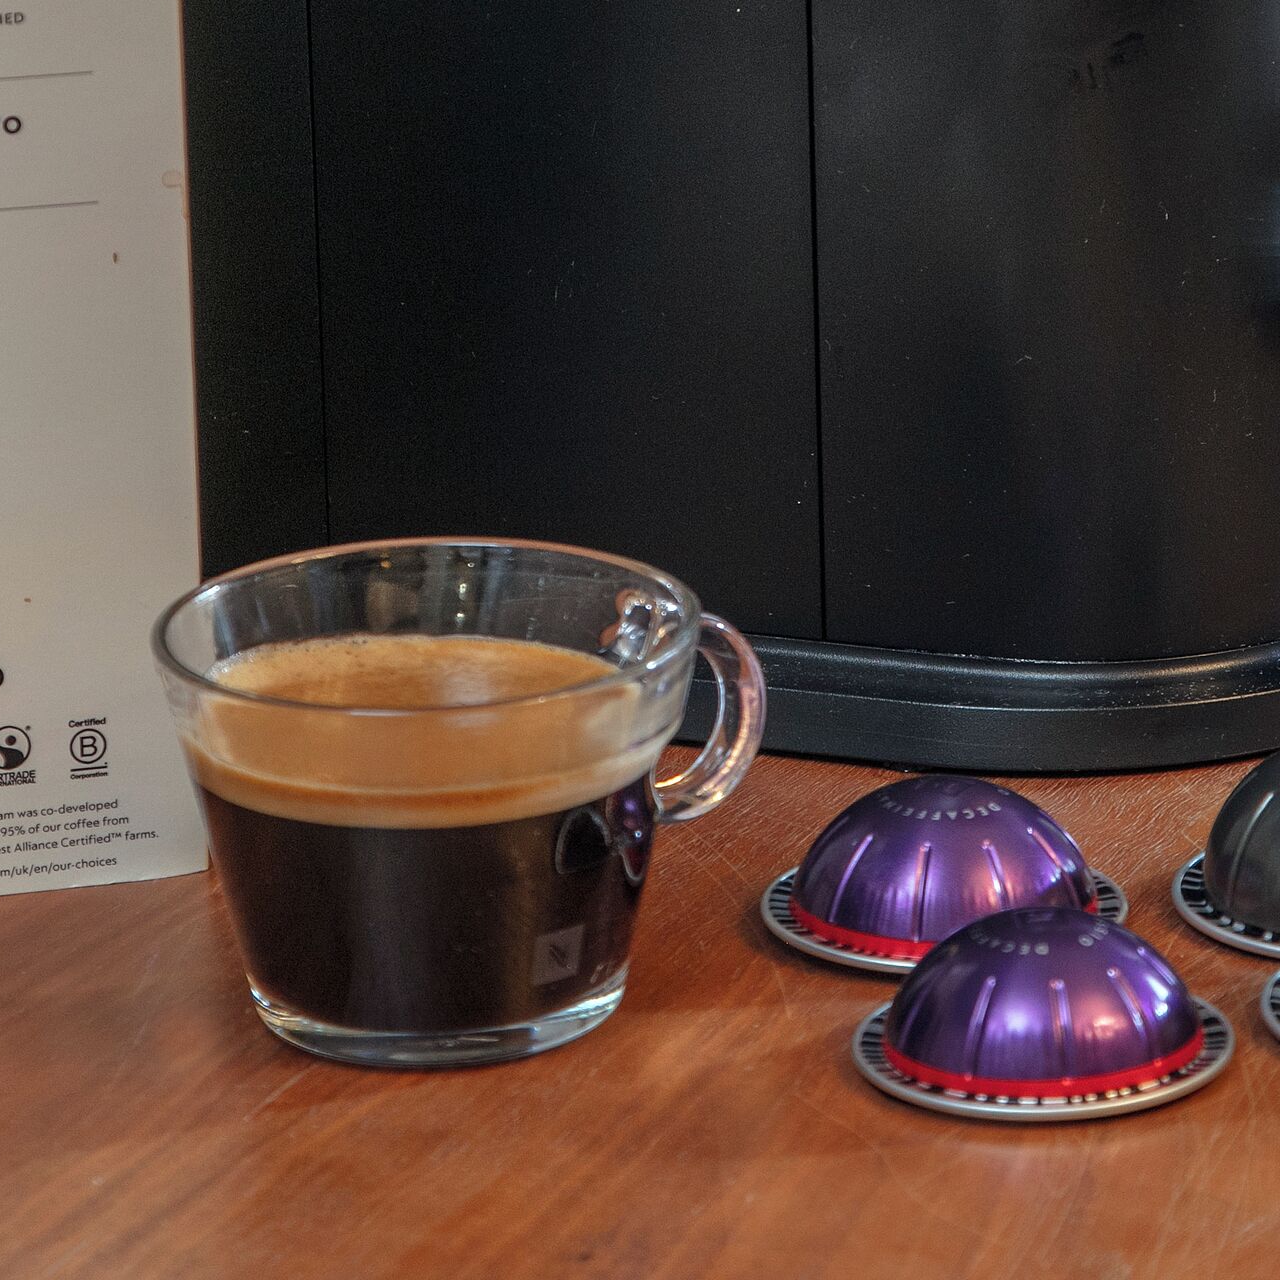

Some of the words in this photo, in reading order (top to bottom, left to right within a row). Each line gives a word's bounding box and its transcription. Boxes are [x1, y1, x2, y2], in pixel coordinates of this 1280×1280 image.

[69, 718, 106, 728] Certified
[80, 735, 98, 757] B
[70, 771, 108, 780] Corporation
[17, 808, 38, 818] was
[40, 799, 118, 817] co-developed
[0, 826, 25, 838] 95%
[28, 823, 40, 834] of
[42, 823, 61, 833] our
[64, 818, 100, 831] coffee
[102, 815, 129, 827] from
[14, 840, 58, 853] Alliance
[125, 830, 159, 841] farms.
